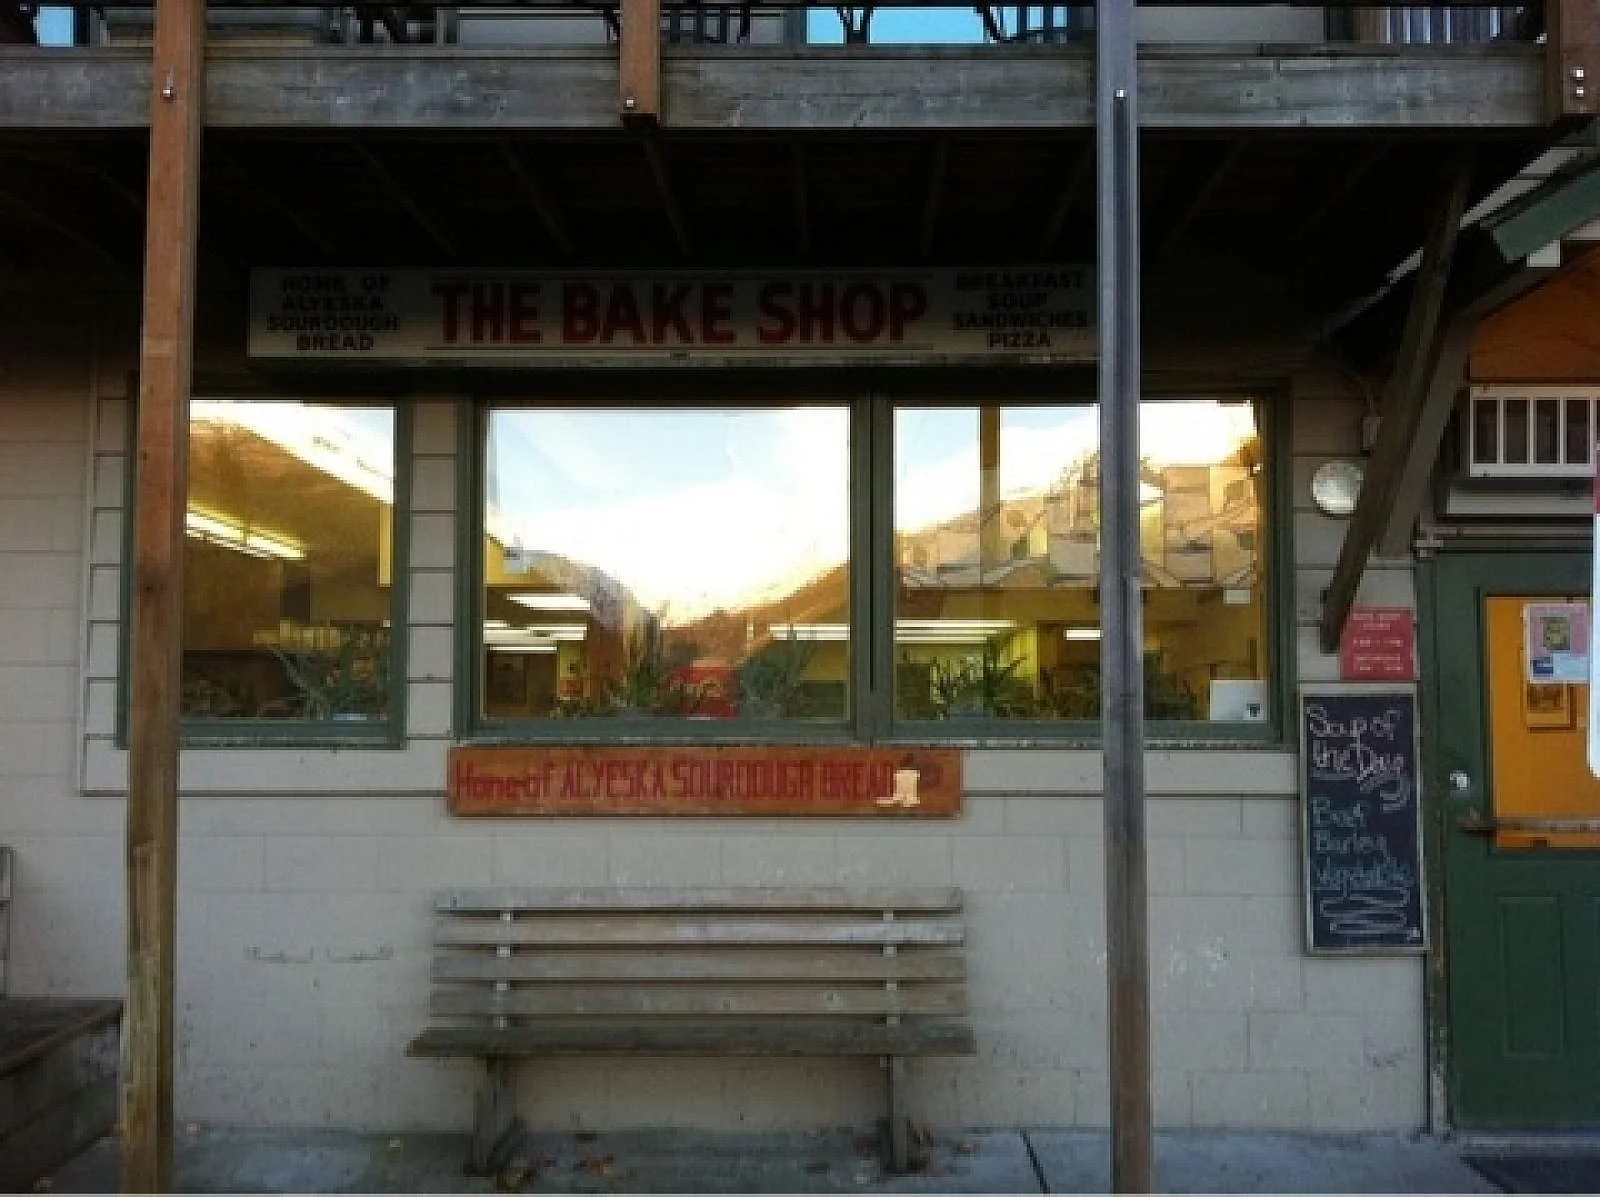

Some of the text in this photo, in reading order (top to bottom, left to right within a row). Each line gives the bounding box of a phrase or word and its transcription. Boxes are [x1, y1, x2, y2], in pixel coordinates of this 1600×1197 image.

[283, 275, 391, 293] HOME OF
[955, 271, 1085, 289] BREAKFAST
[282, 295, 384, 311] ALYESKA
[988, 292, 1048, 308] SOUP
[432, 281, 927, 343] THE BAKE SHOP
[952, 312, 1088, 329] SANDWICHES
[267, 315, 400, 331] SOURDOUGH
[296, 334, 374, 351] BREAD
[987, 330, 1051, 348] PIZZA
[1370, 708, 1403, 741] of
[1312, 739, 1353, 774] the
[456, 759, 519, 799] Home
[521, 760, 557, 799] of
[560, 758, 664, 799] ALYESKA
[672, 758, 813, 800] SOURDOUGH
